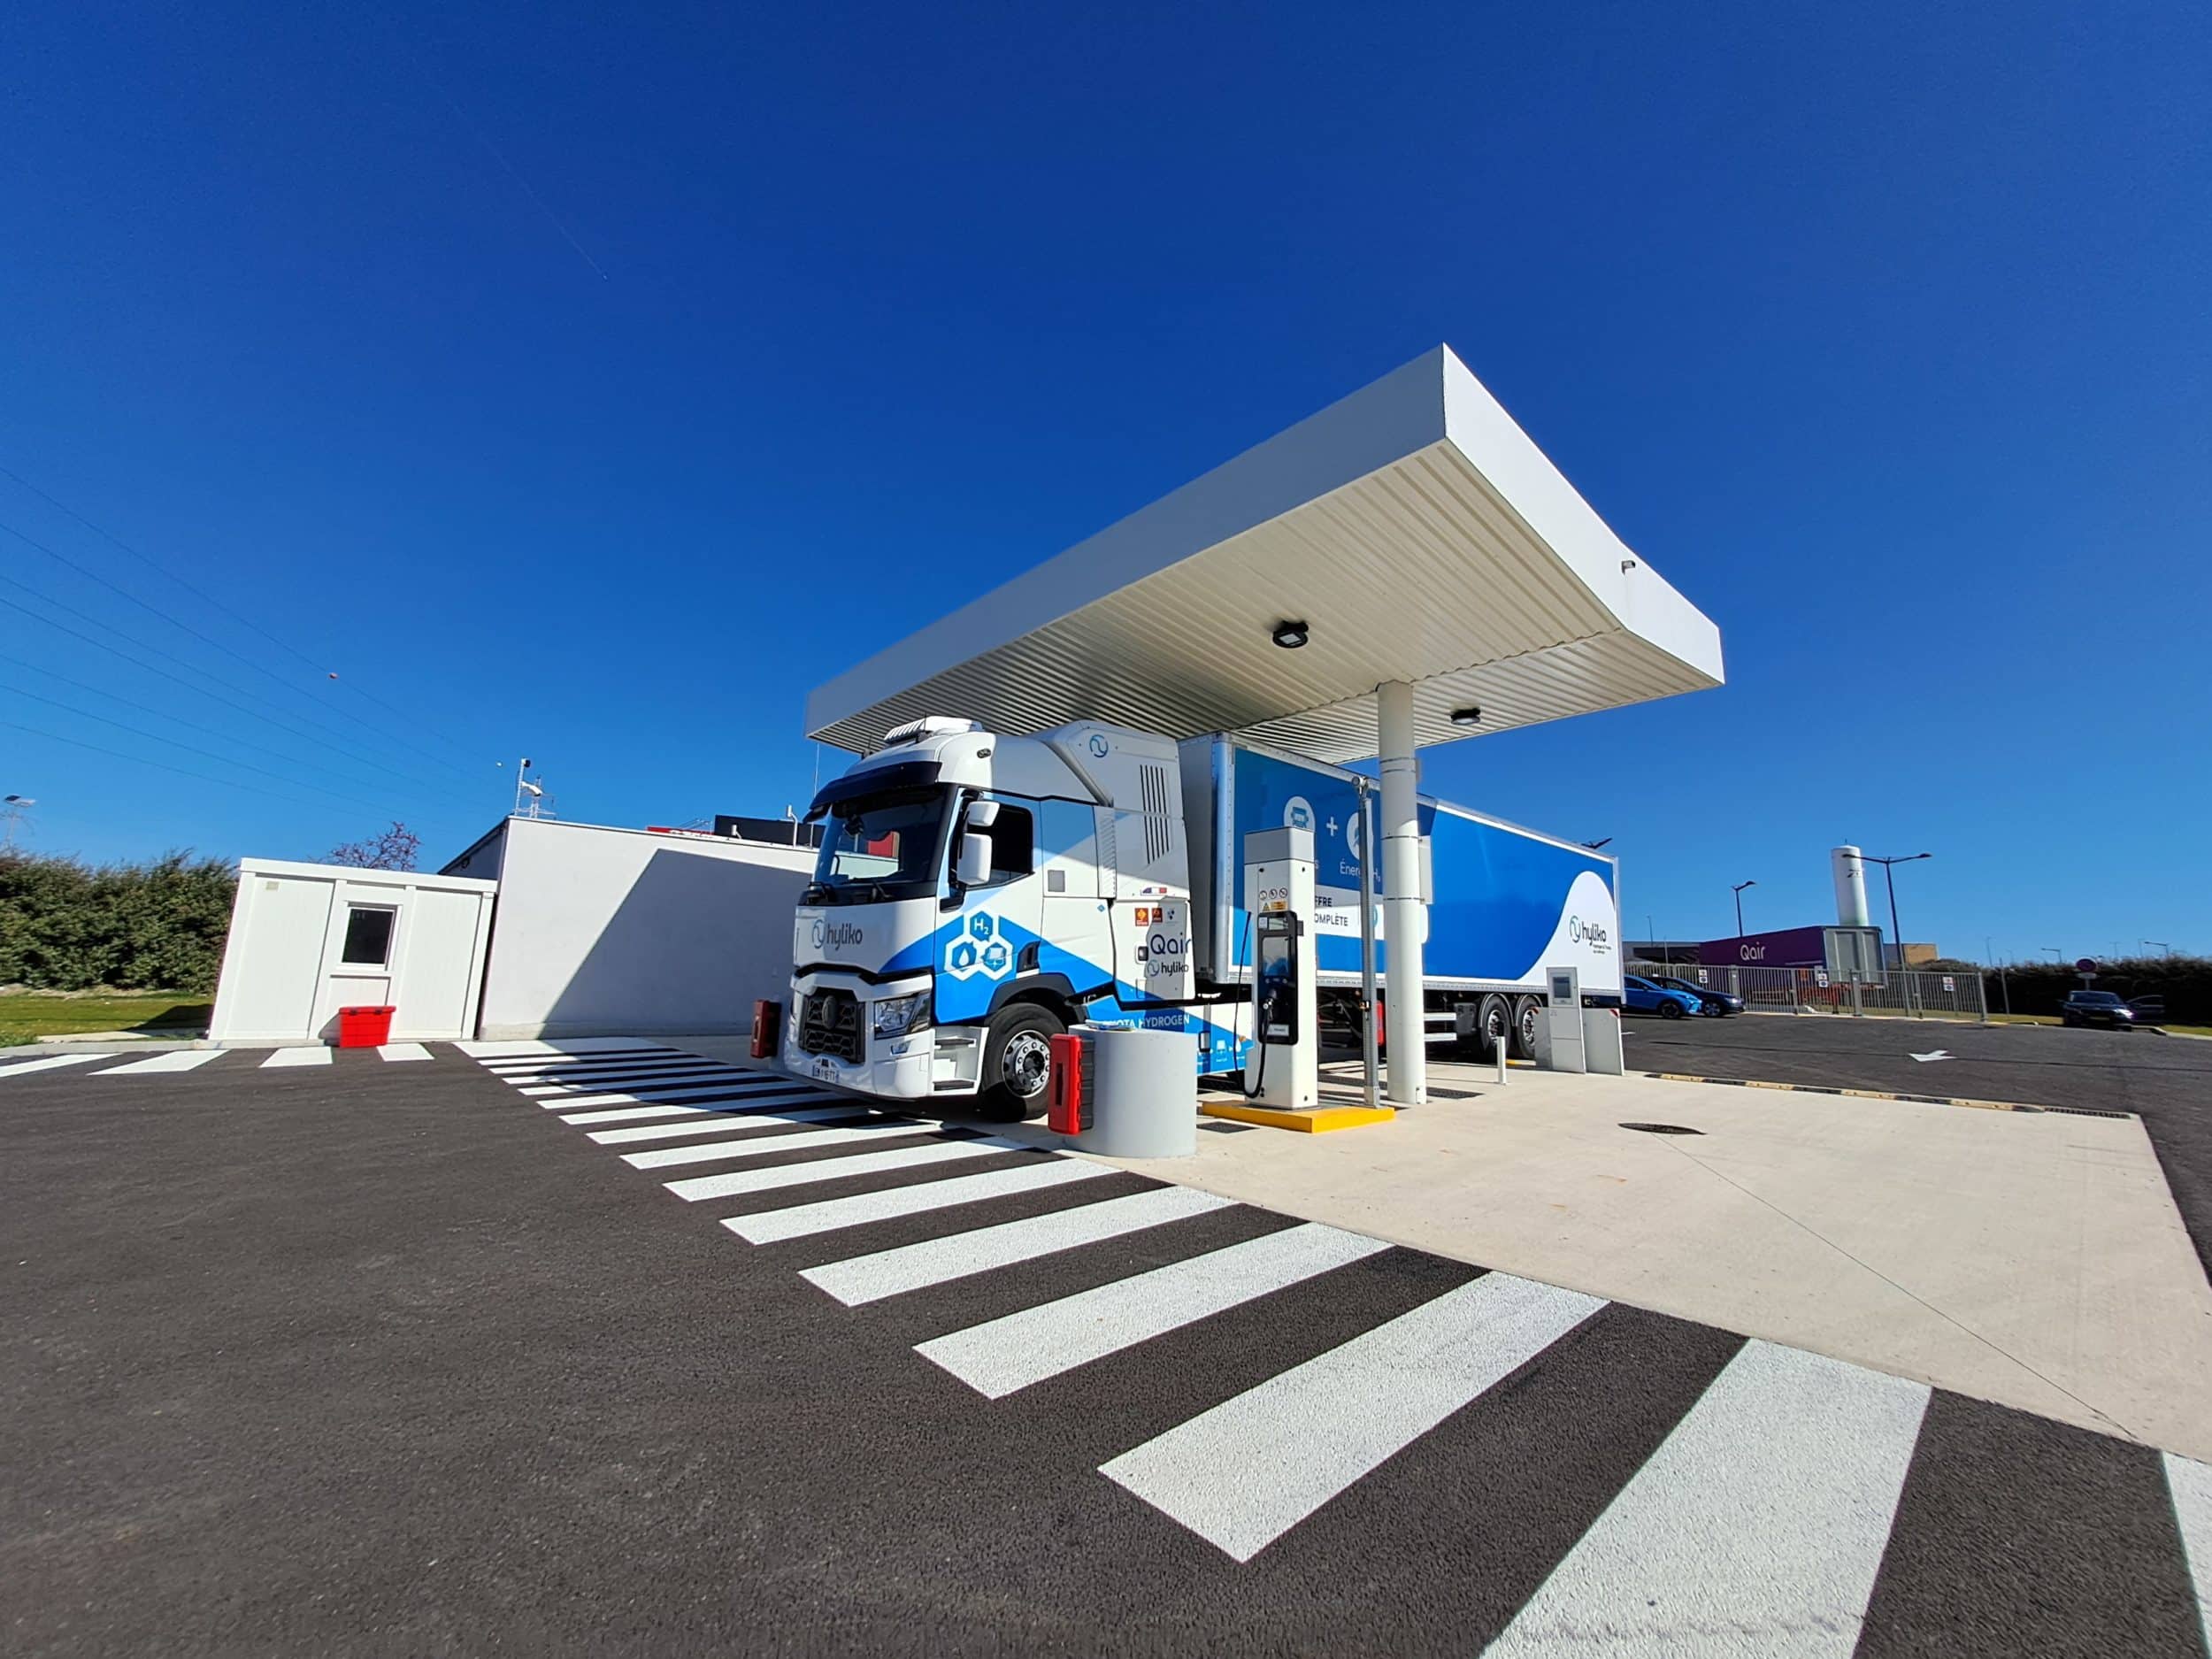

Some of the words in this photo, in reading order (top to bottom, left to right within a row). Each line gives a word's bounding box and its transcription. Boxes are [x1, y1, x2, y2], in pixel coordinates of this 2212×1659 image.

[1315, 895, 1333, 907] FFRE
[974, 918, 989, 935] H2
[1314, 913, 1348, 926] OMPLÈTE
[826, 923, 863, 951] hyliko
[1581, 920, 1607, 946] hyliko
[1150, 932, 1192, 955] Qair
[1740, 941, 1766, 961] Qair
[1161, 962, 1189, 977] hyliko
[1138, 1012, 1190, 1028] HYDROGEN
